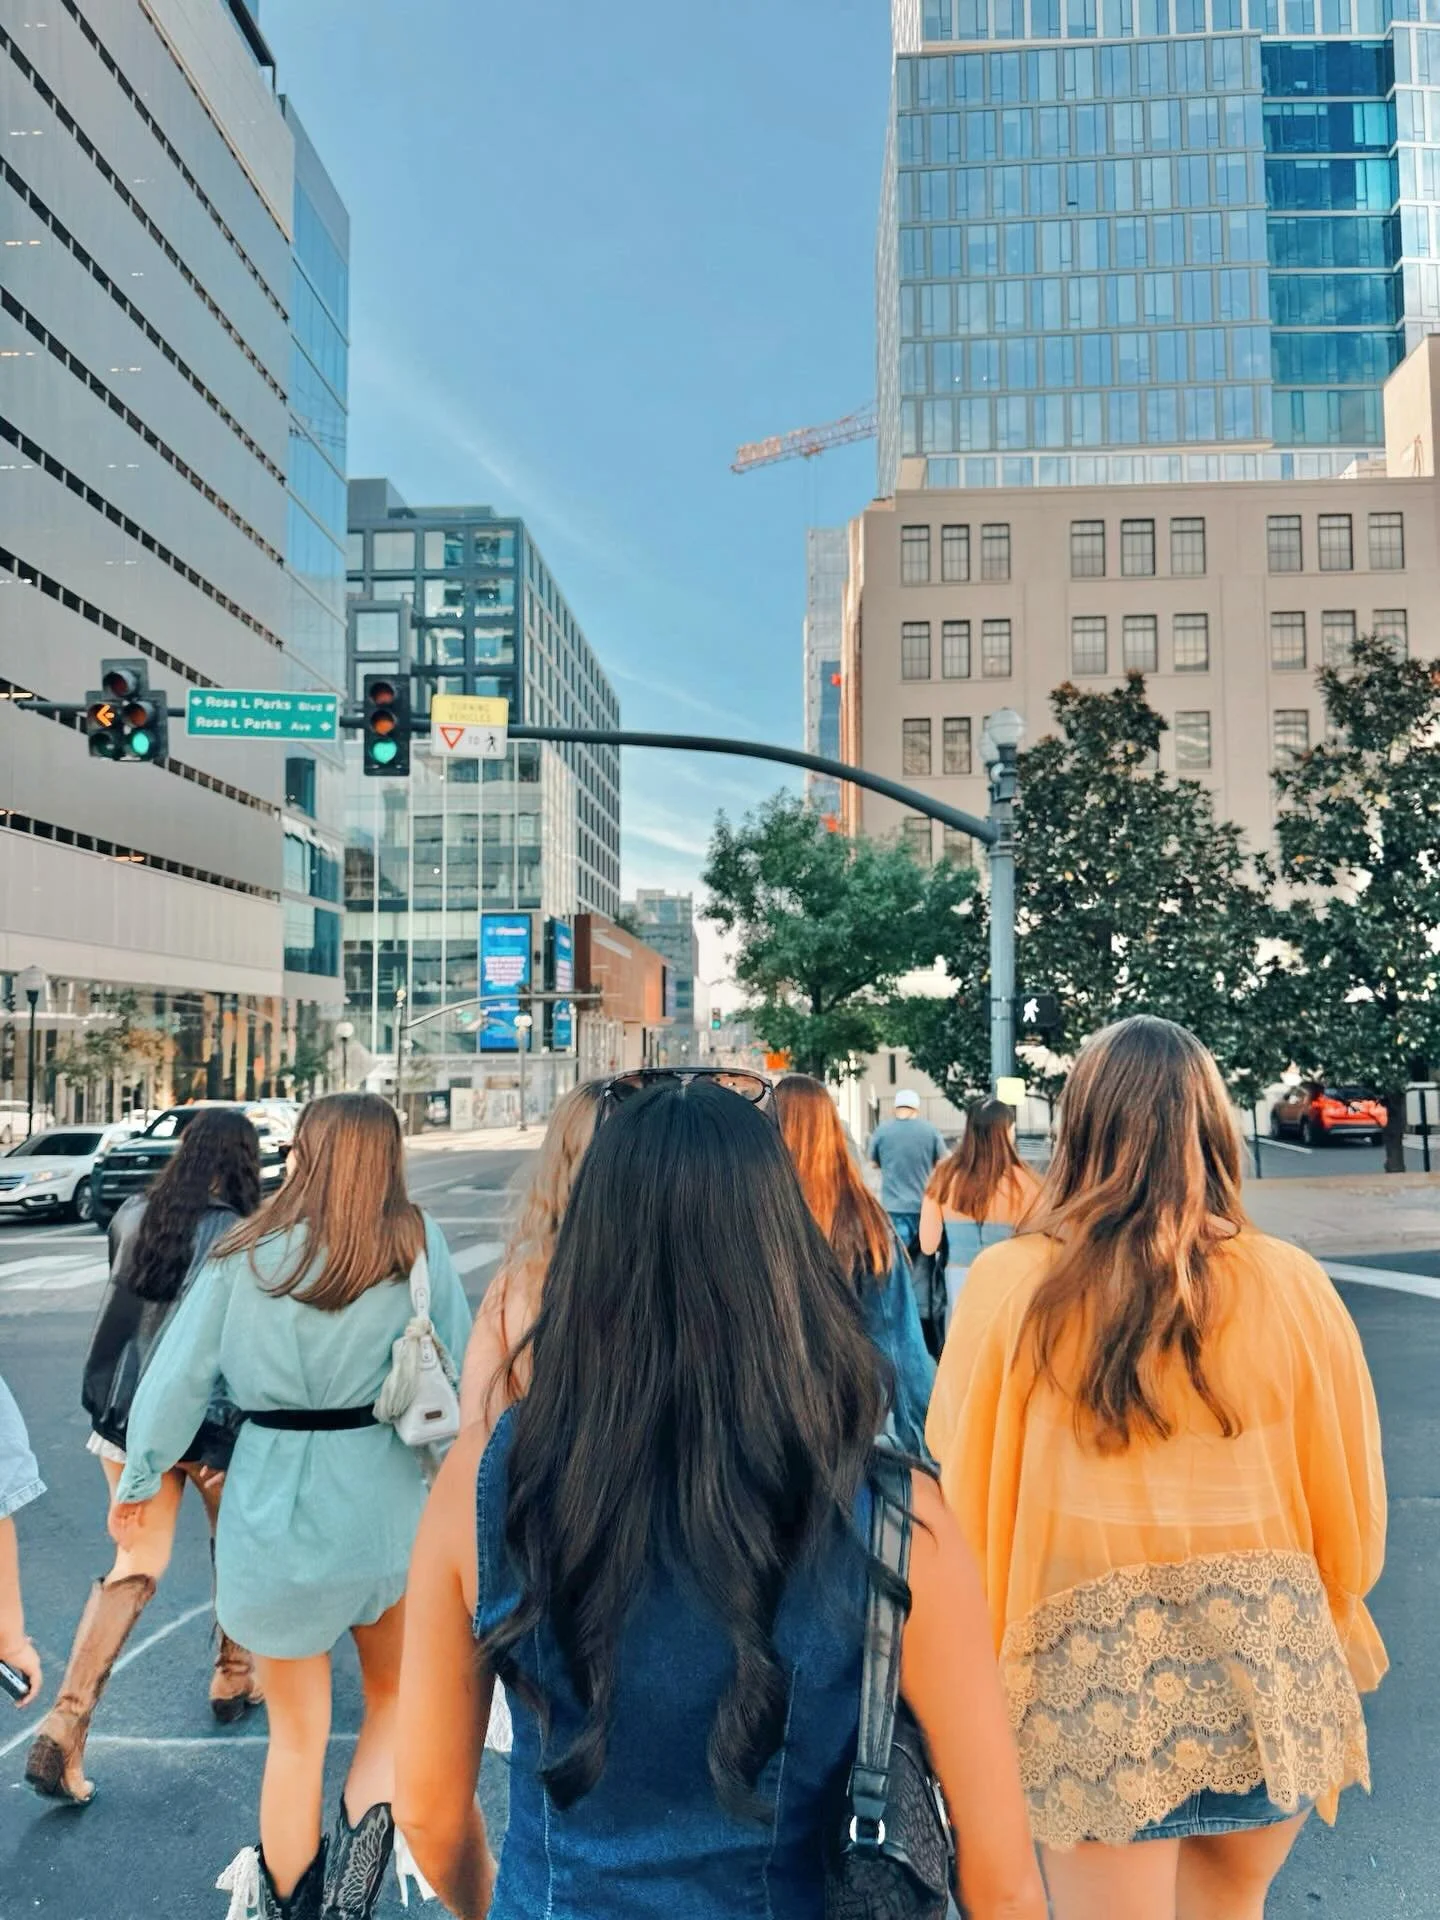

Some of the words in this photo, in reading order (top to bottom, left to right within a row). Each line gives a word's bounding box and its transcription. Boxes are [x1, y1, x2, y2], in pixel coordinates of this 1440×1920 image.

[205, 696, 238, 709] Rosa
[241, 697, 250, 709] L
[254, 698, 292, 711] Parks
[195, 716, 228, 729] Rosa
[231, 717, 240, 729] L
[244, 718, 282, 731] Parks
